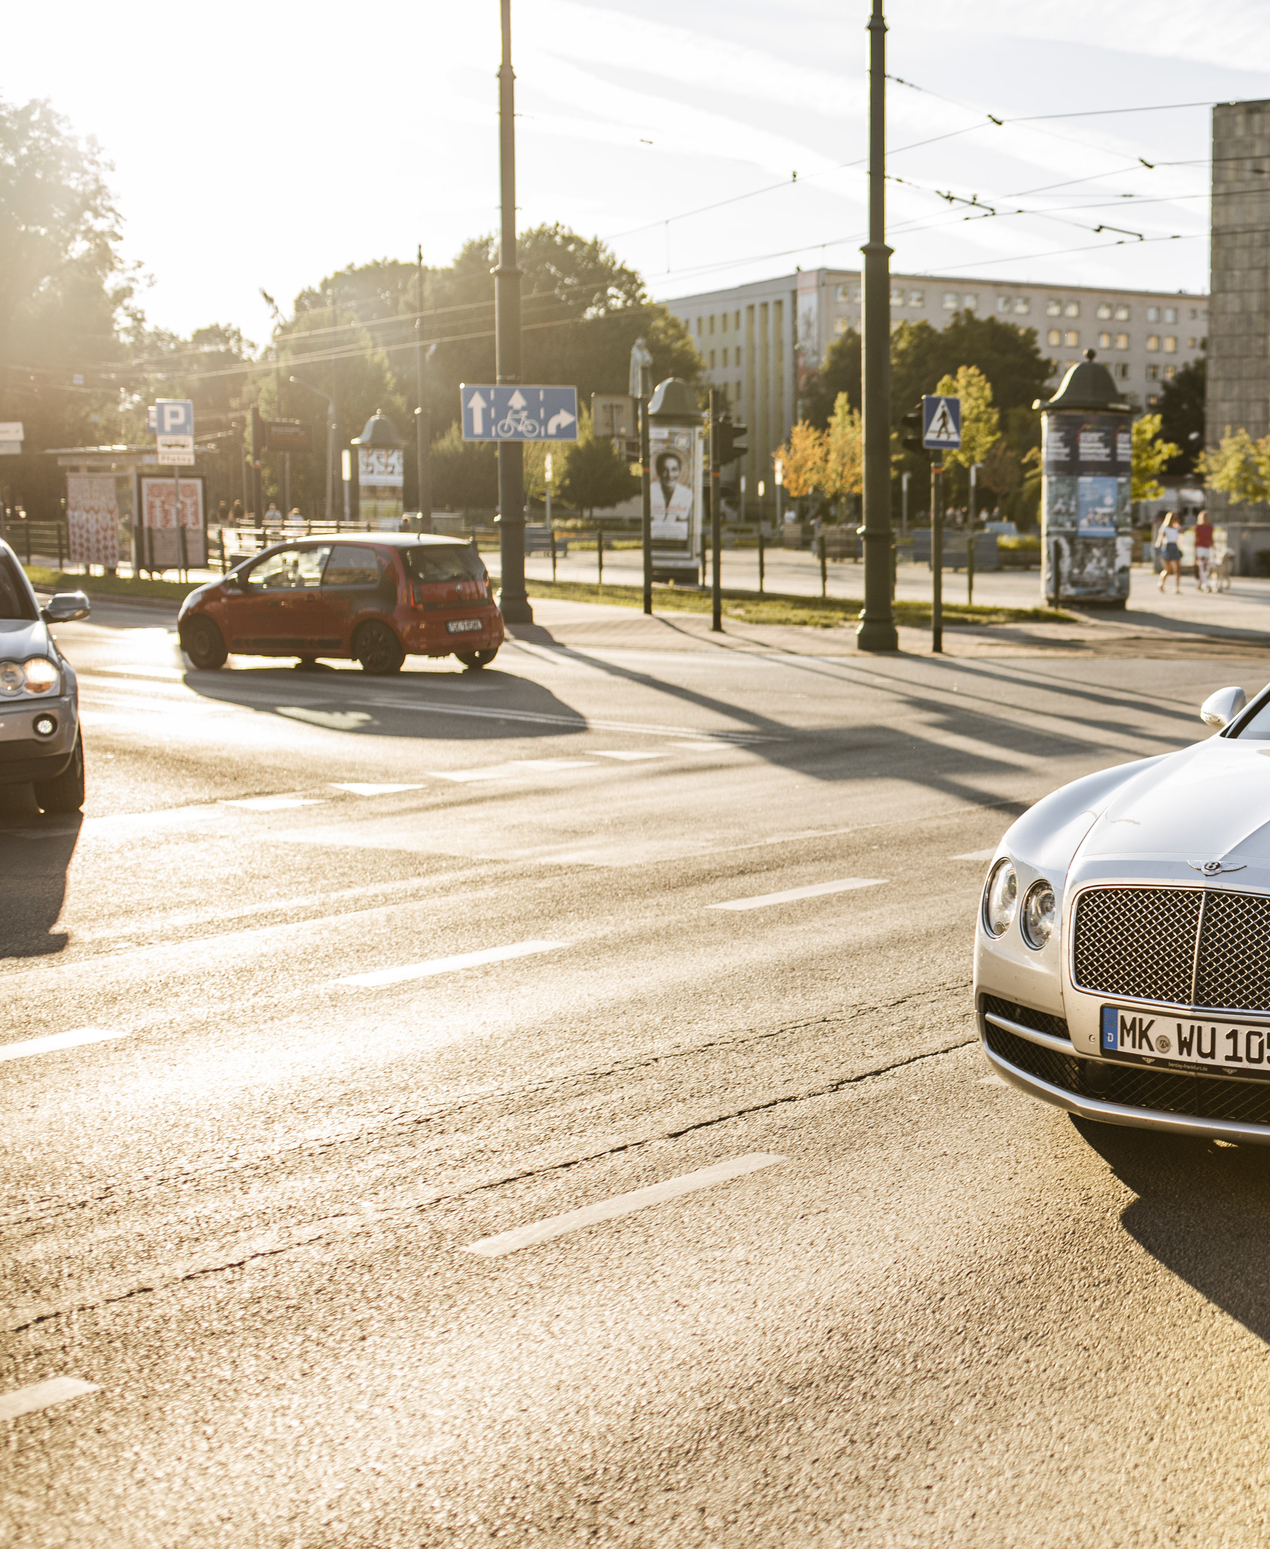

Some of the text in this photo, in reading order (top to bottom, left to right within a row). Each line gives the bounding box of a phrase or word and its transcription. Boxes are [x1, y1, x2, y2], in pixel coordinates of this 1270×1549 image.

[163, 404, 185, 432] P
[1107, 1032, 1114, 1042] D
[1120, 1014, 1156, 1052] MK
[1176, 1022, 1216, 1060] WU
